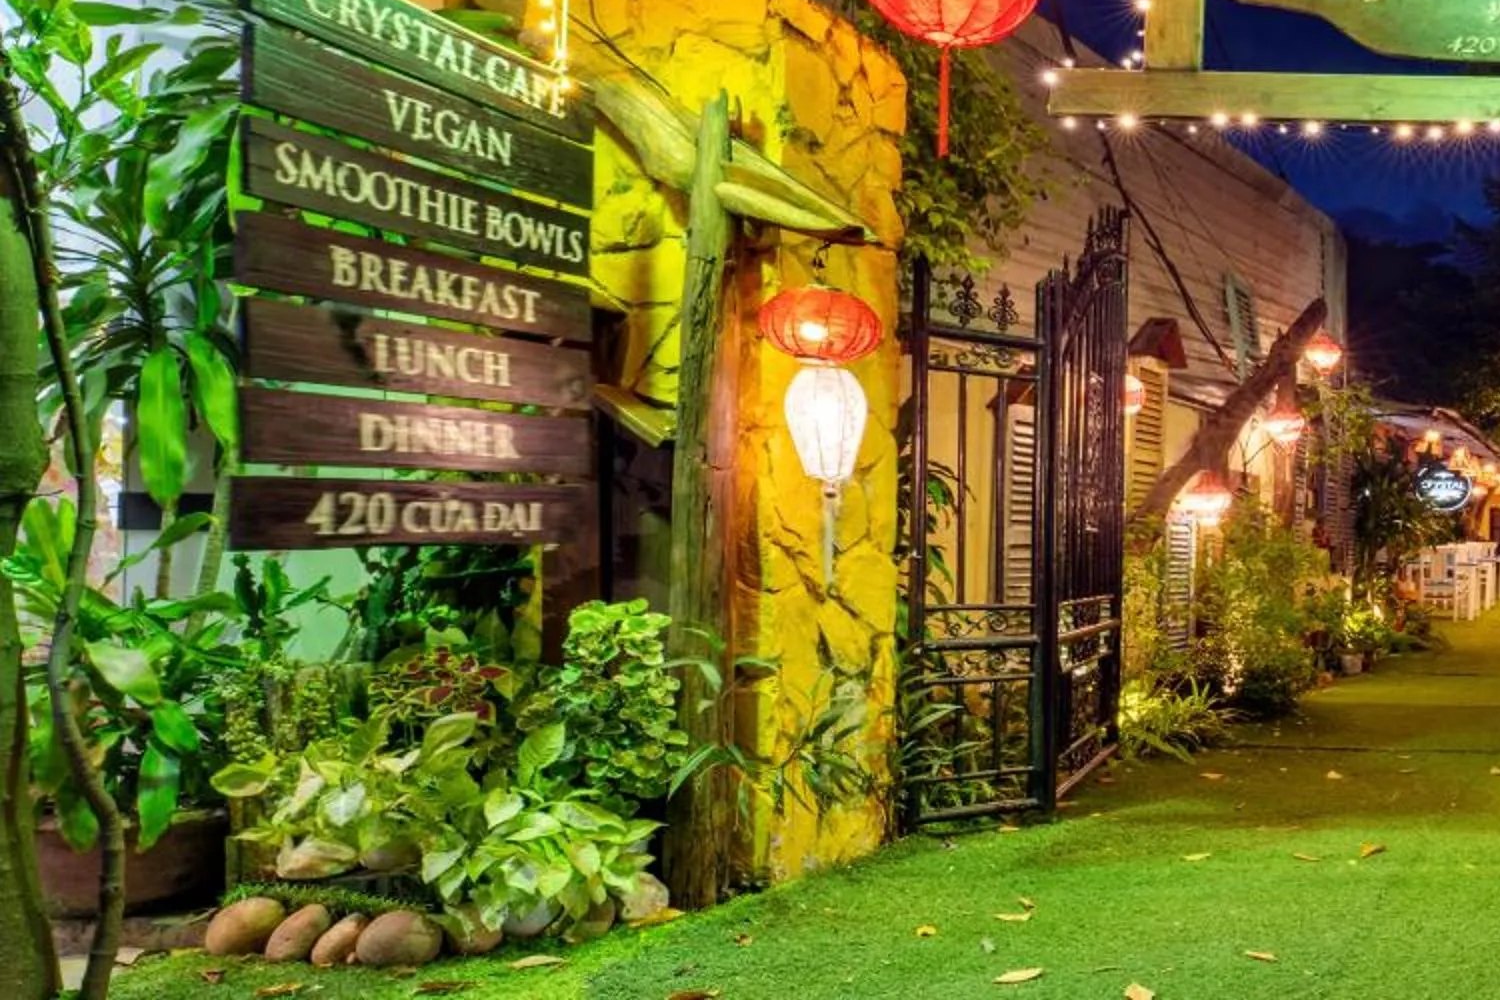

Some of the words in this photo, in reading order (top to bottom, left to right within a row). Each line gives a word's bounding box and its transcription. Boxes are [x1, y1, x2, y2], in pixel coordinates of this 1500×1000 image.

[1447, 36, 1495, 54] 420
[384, 90, 513, 166] VEGAN
[275, 141, 480, 235] SMOOTHIE
[485, 205, 584, 263] BOWLS
[329, 245, 541, 323] BREAKFAST
[373, 334, 512, 387] LUNCH
[359, 413, 521, 460] DINNER
[305, 491, 396, 536] 420
[483, 502, 543, 537] ĐẠI
